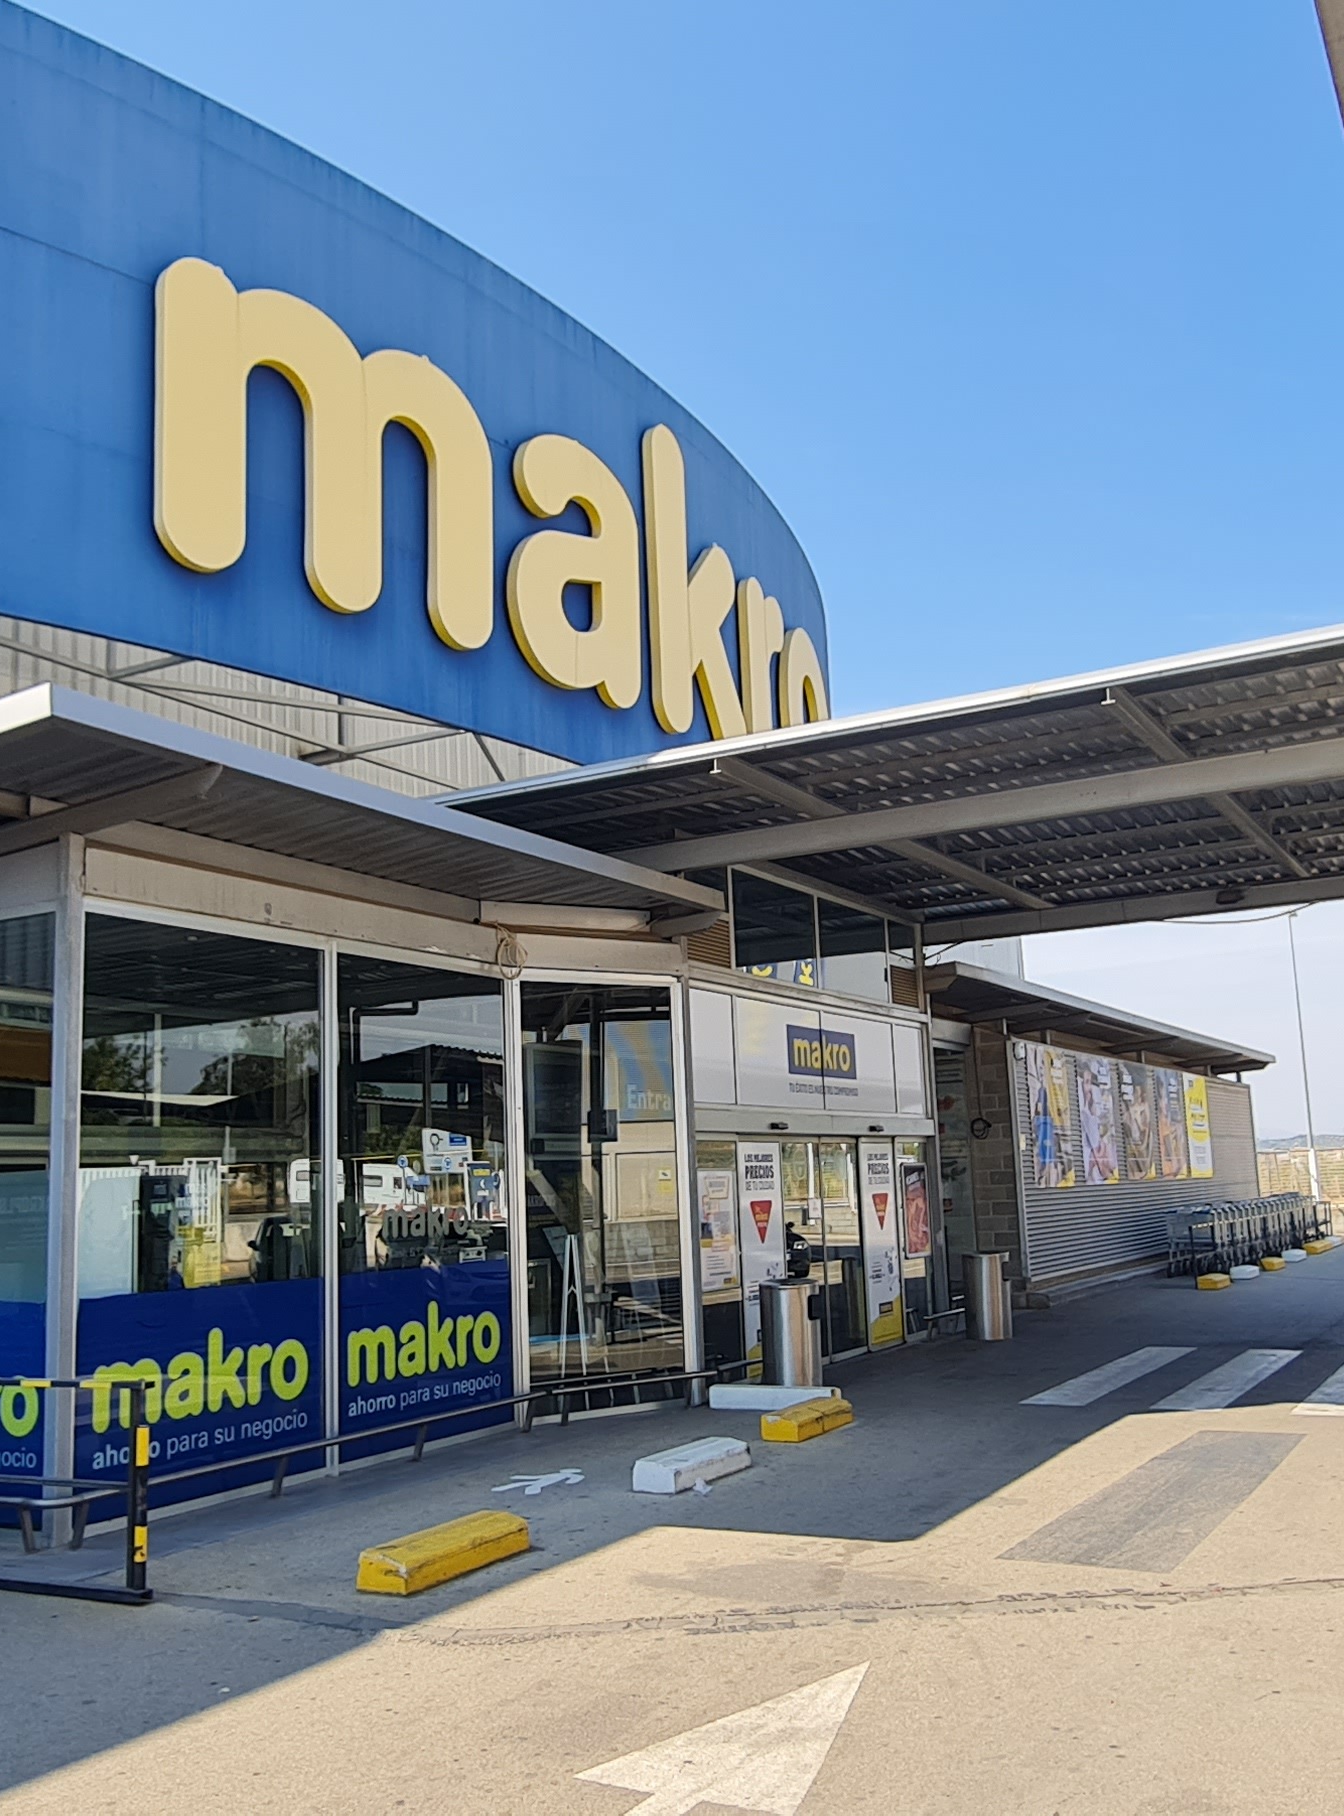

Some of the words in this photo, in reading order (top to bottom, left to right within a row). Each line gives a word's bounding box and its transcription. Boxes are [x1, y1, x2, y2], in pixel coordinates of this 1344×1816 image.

[154, 256, 831, 741] makro
[793, 1035, 851, 1072] makro
[745, 1165, 774, 1179] PRECIOS
[382, 1204, 468, 1241] makro
[347, 1300, 501, 1388] makro
[91, 1327, 309, 1434] makro
[347, 1394, 396, 1417] ahorro
[399, 1389, 430, 1407] para
[433, 1383, 449, 1398] su
[453, 1370, 501, 1397] negocio
[166, 1433, 209, 1459] para
[214, 1425, 235, 1445] su
[241, 1409, 308, 1442] negocio
